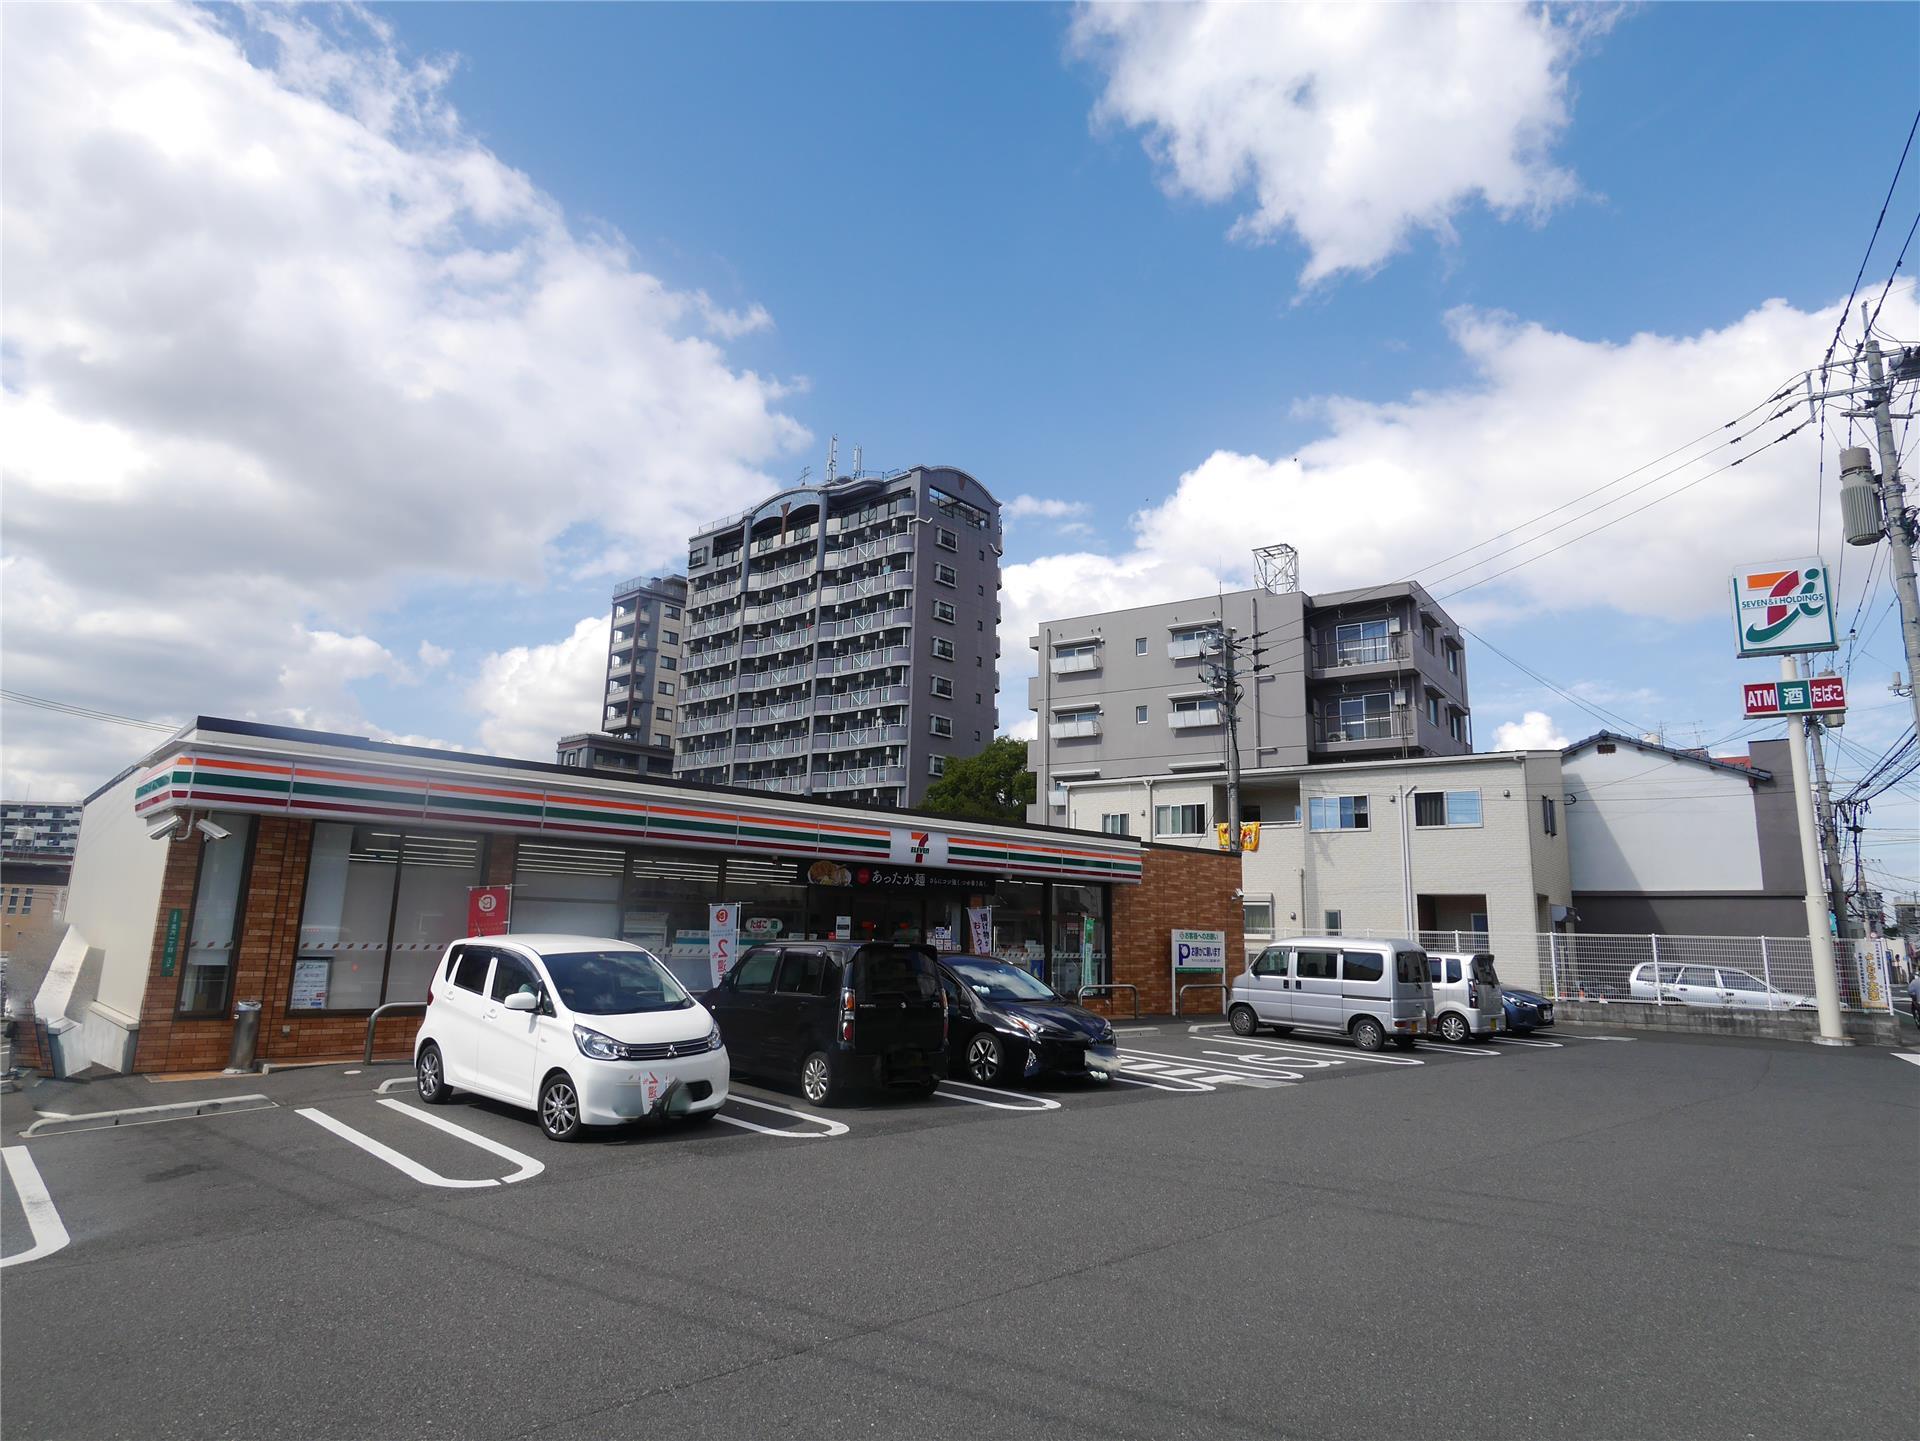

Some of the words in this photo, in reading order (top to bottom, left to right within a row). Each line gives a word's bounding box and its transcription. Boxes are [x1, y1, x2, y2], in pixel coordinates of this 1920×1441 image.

[1779, 593, 1824, 604] HOLDINGS
[1747, 689, 1776, 707] ATM
[1783, 688, 1804, 705] 酒
[1811, 684, 1844, 702] たばこ
[872, 869, 926, 886] あったか麺
[1179, 944, 1190, 965] P
